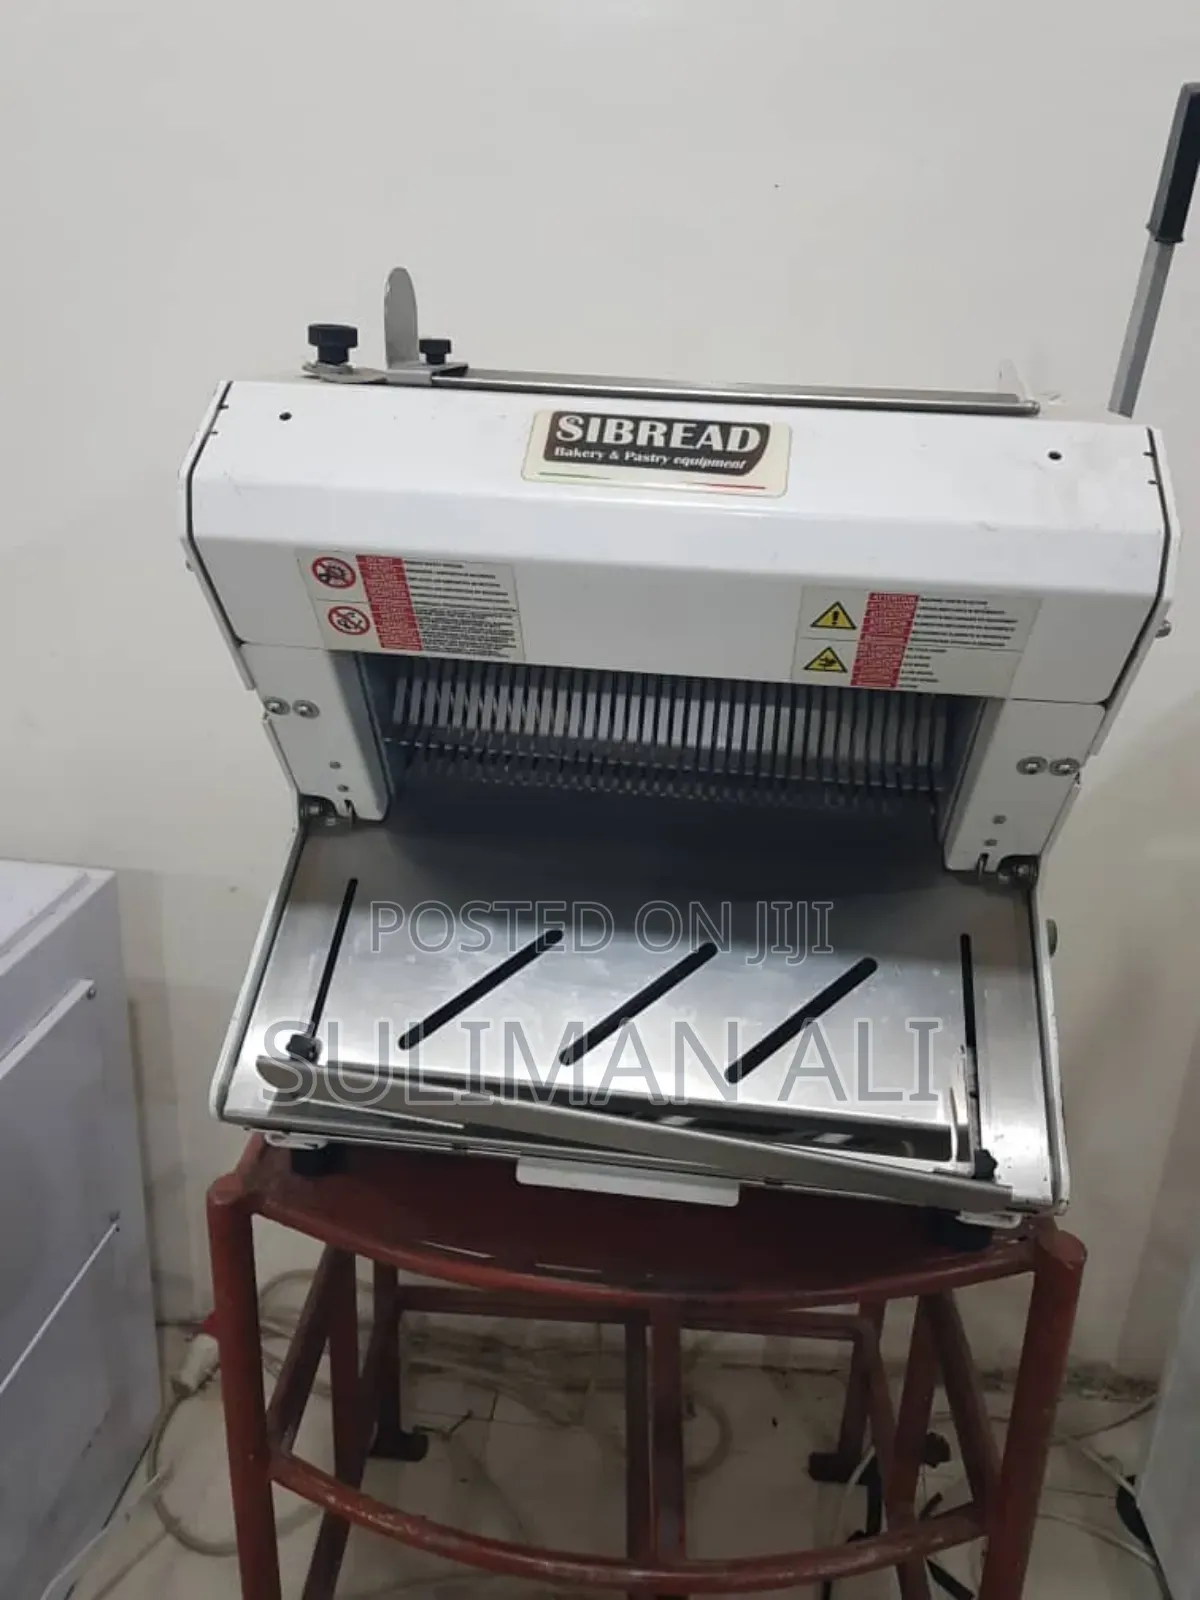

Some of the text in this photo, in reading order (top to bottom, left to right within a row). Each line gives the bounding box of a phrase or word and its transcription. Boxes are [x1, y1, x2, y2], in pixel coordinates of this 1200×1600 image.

[556, 415, 760, 453] SIBREAD
[554, 446, 748, 471] Bakery & Pastry equipment
